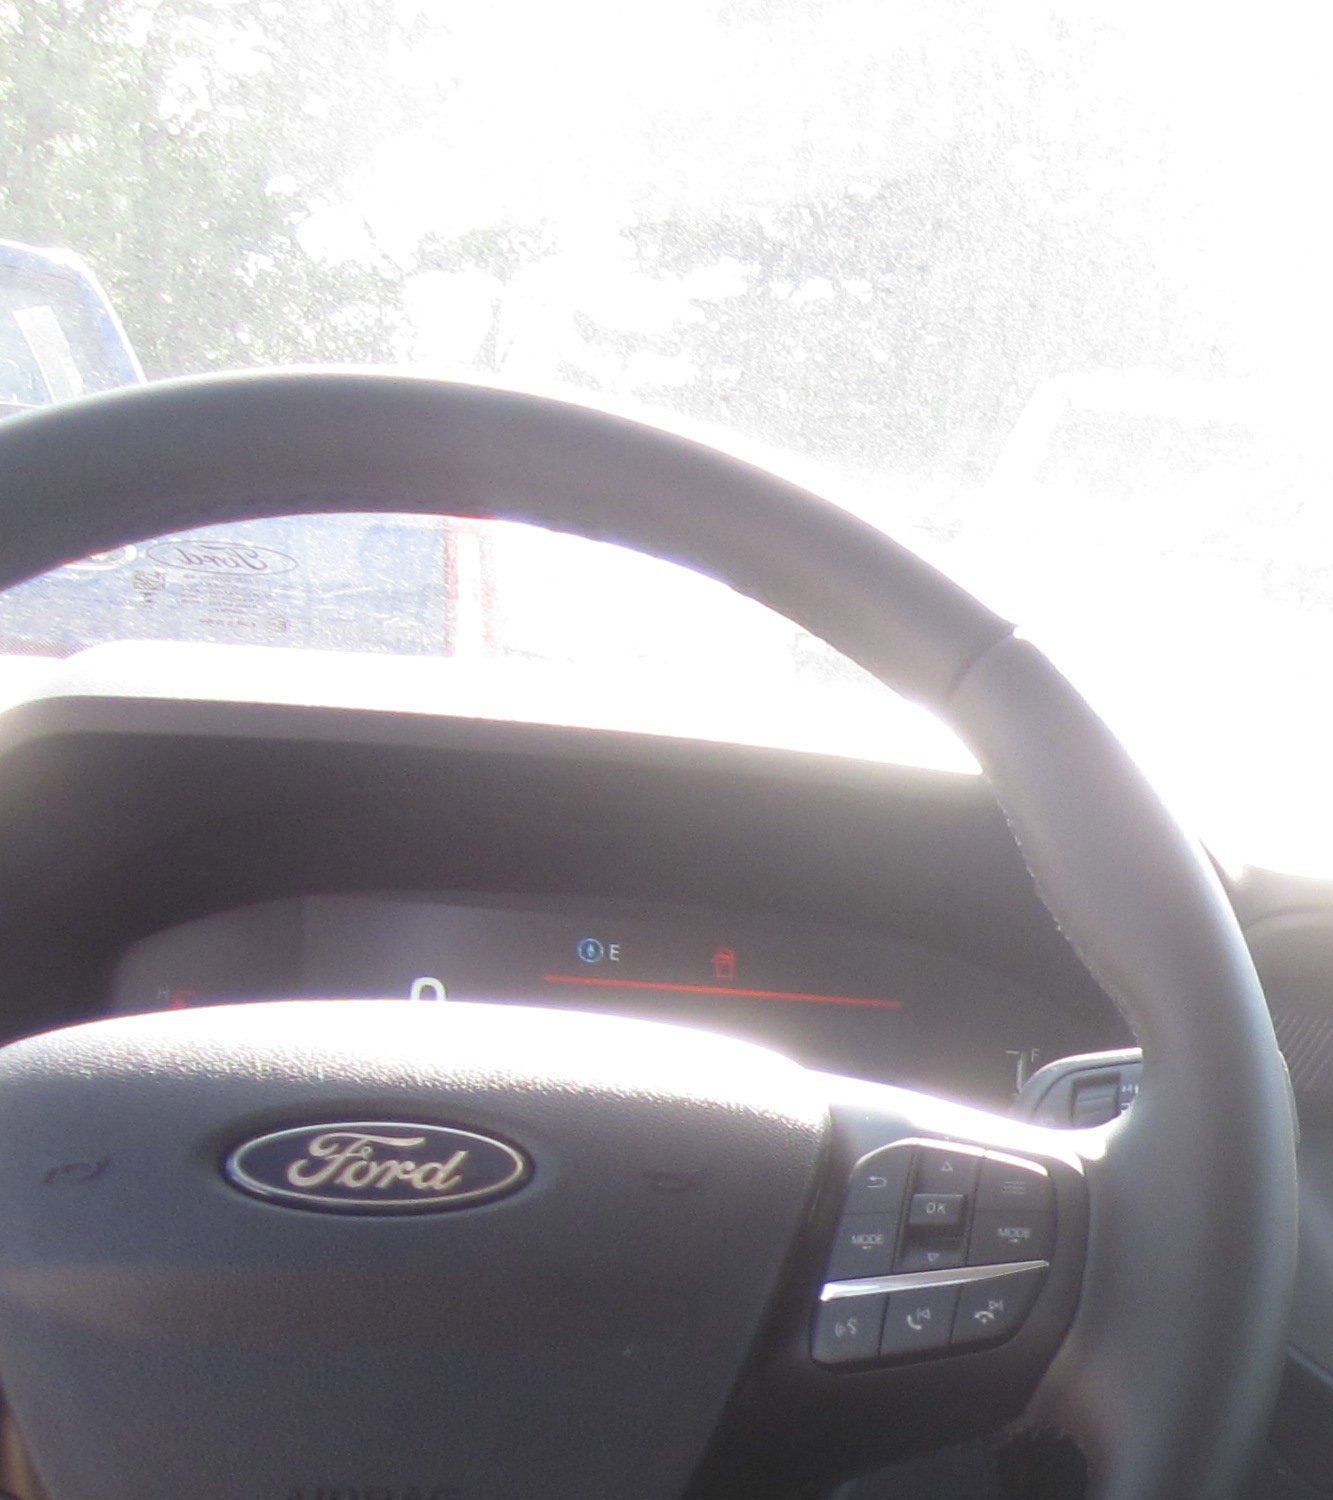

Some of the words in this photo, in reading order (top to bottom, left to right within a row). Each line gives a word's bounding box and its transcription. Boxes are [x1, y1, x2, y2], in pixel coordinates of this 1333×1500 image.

[608, 943, 620, 961] E
[286, 1131, 469, 1191] Ford
[925, 1201, 947, 1216] OK
[851, 1234, 884, 1246] MODE
[998, 1227, 1032, 1240] MODE
